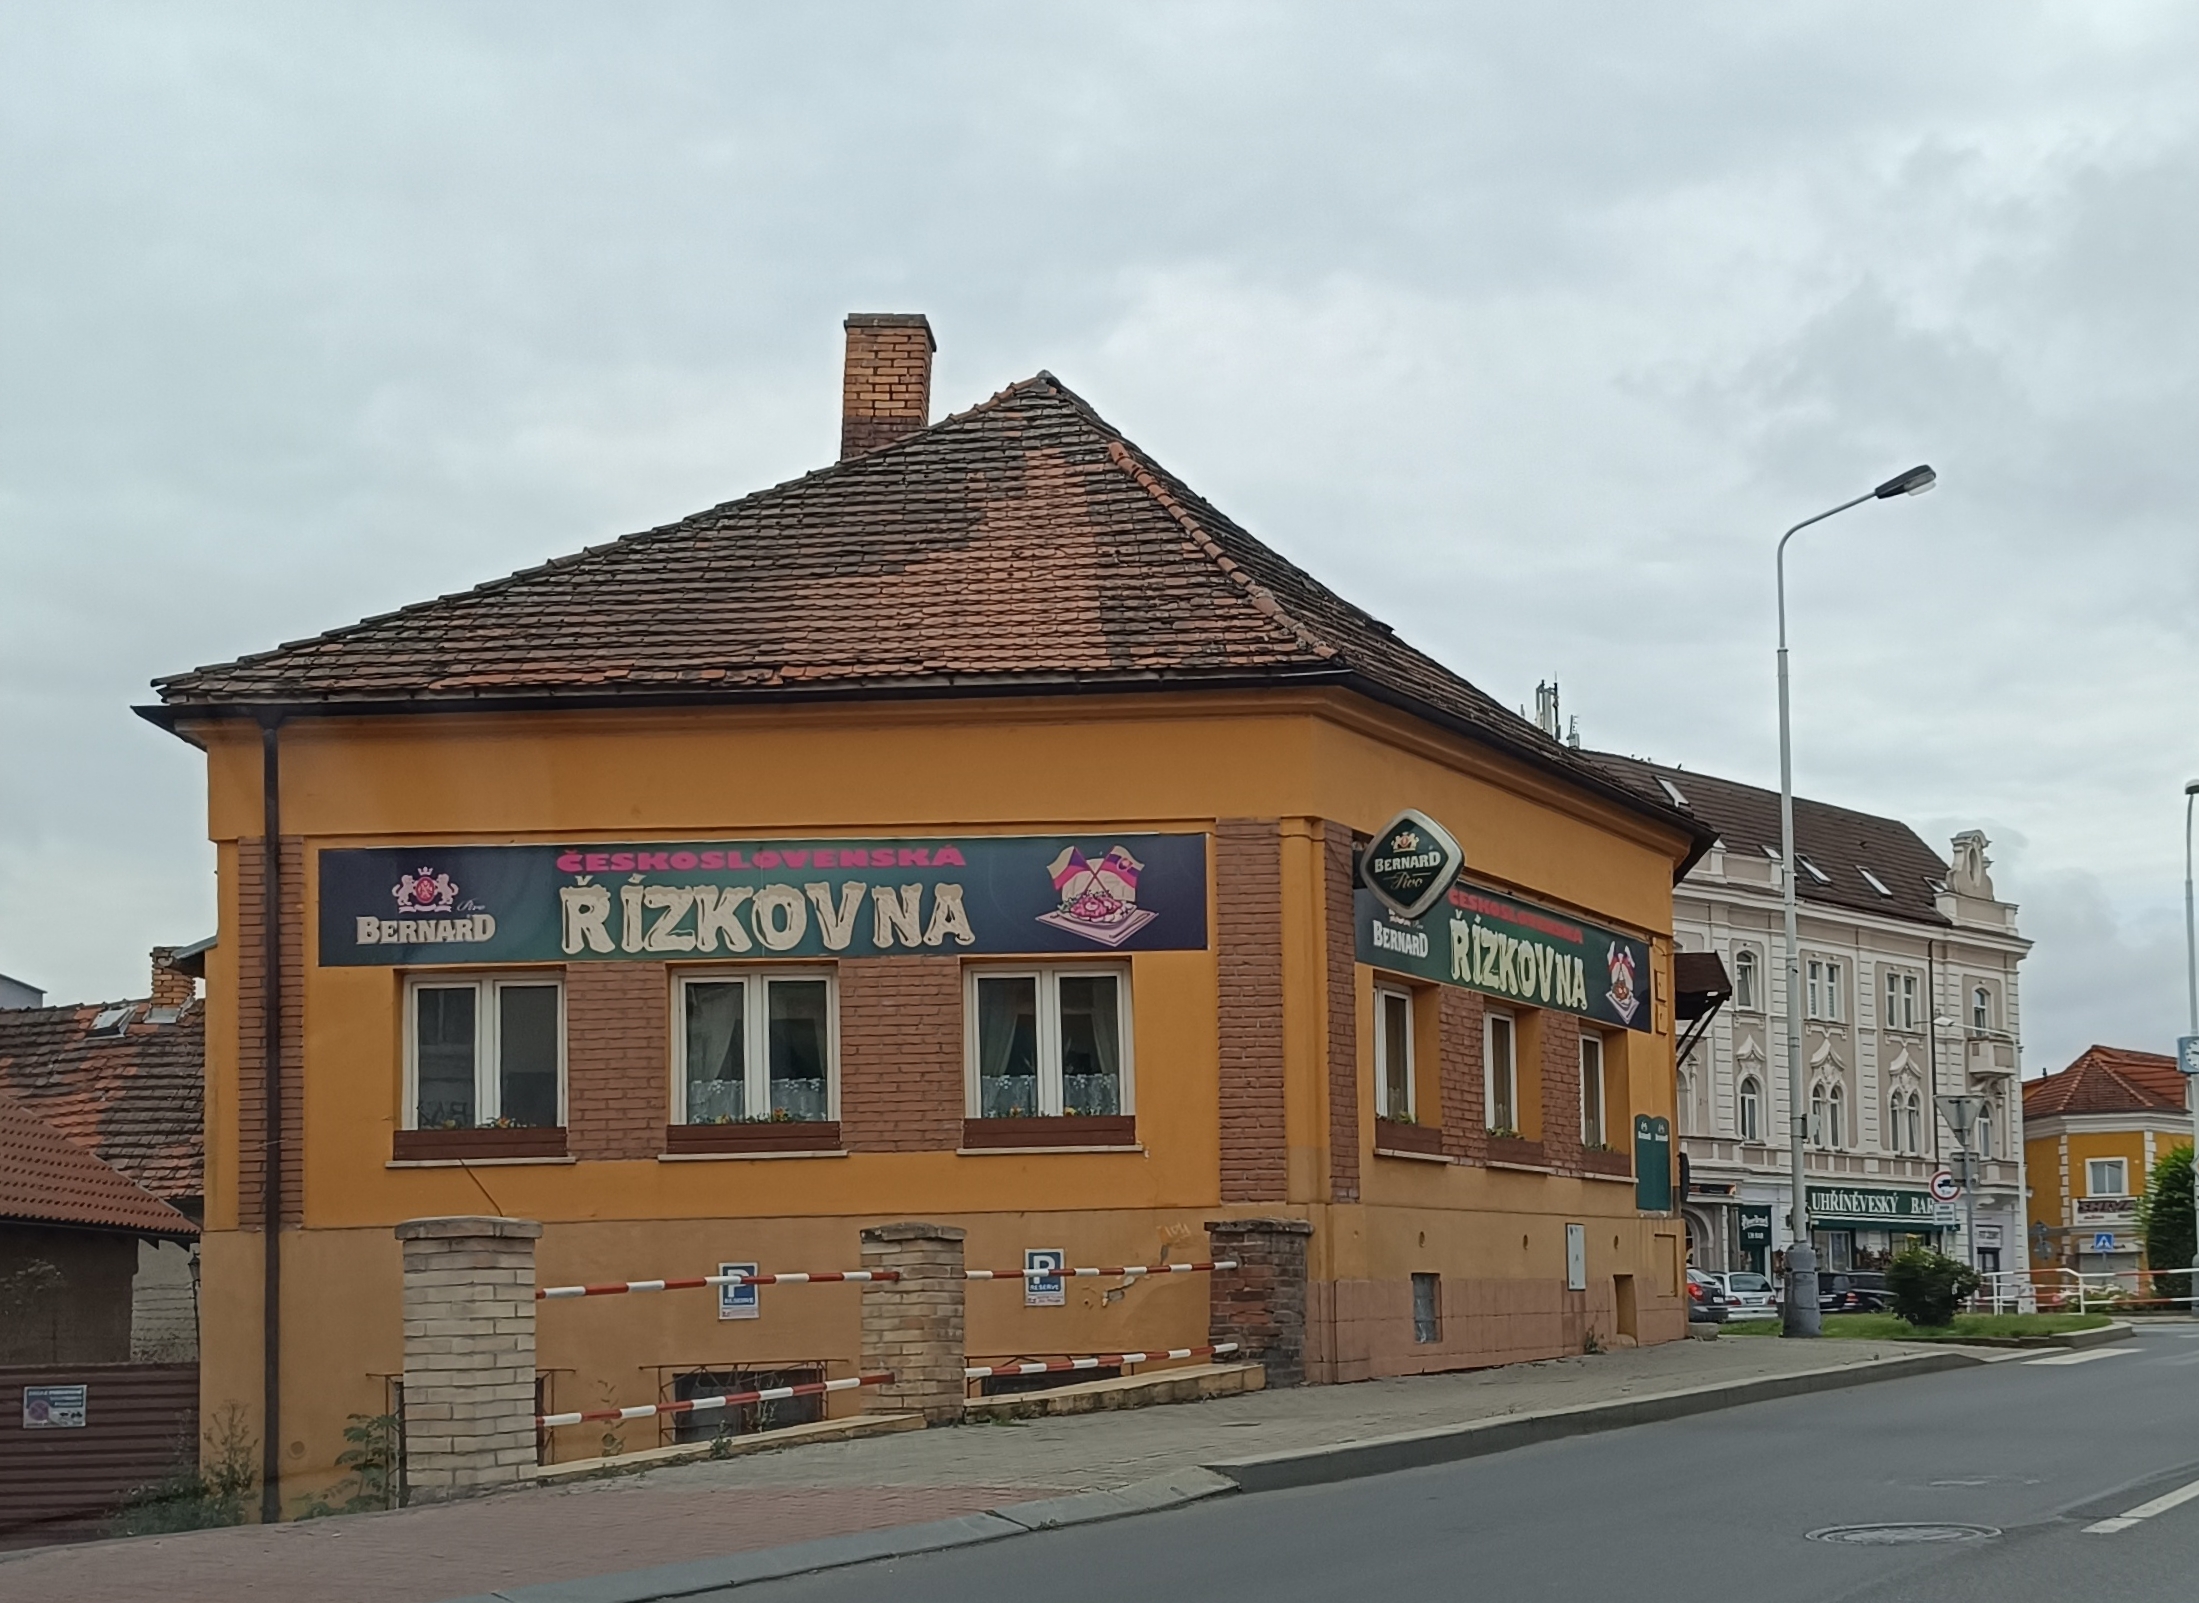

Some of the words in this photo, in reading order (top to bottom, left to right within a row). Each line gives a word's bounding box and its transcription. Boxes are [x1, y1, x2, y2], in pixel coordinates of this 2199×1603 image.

[557, 844, 967, 873] ČESKOSLOVENSKÁ
[1374, 851, 1441, 873] BERNARD
[356, 914, 496, 945] BERNARD
[559, 874, 976, 955] ŘÍZKOVNA
[1373, 920, 1429, 958] BERNARD
[1449, 909, 1588, 1011] ŘÍZKOVNA
[1811, 1189, 1898, 1214] UHŘÍNĚVESKÝ
[1911, 1197, 1934, 1214] BAR
[1033, 1255, 1056, 1284] P
